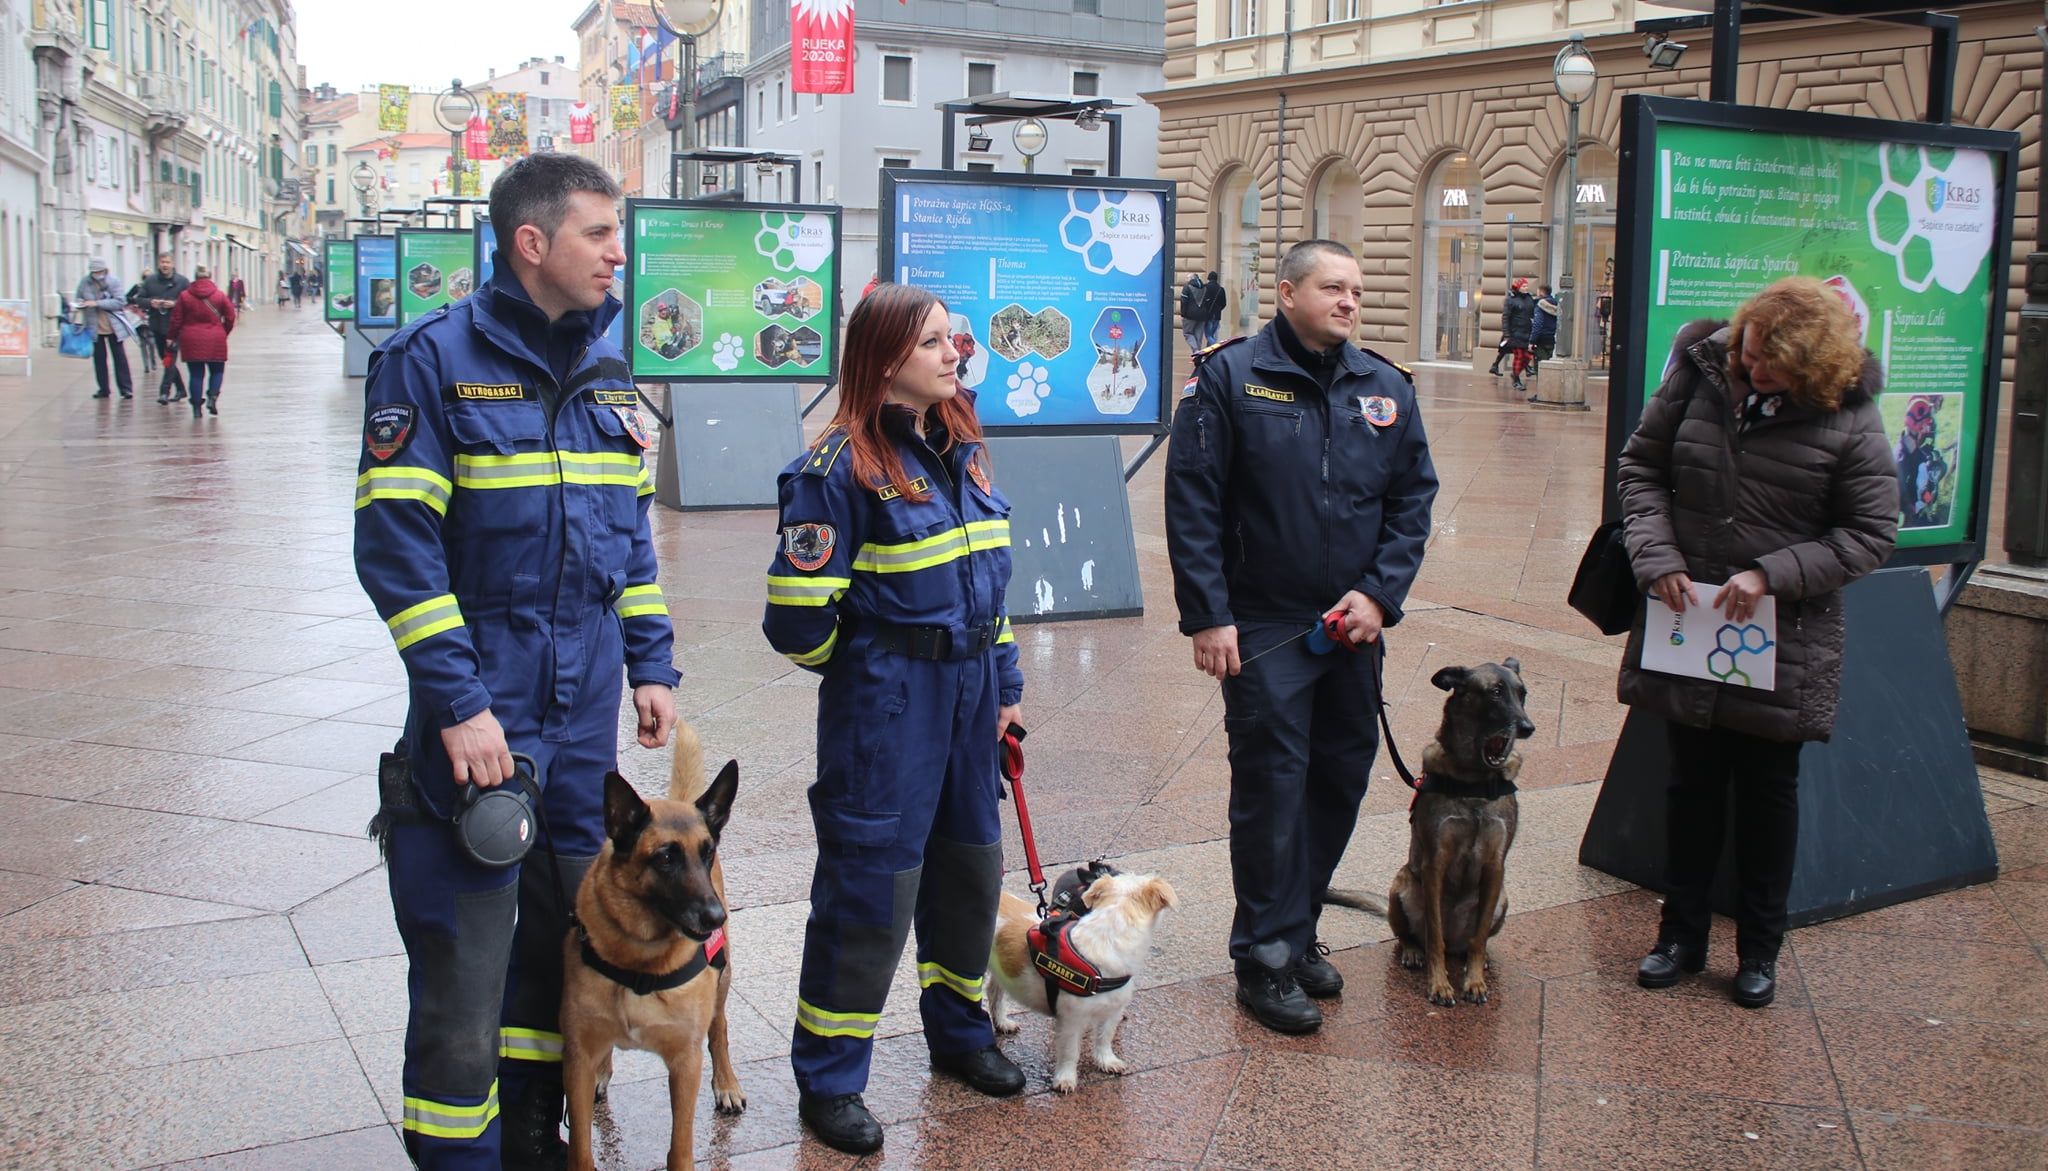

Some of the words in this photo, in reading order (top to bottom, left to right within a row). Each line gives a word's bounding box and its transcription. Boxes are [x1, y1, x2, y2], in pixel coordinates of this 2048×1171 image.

[801, 38, 846, 50] RIJEKA
[801, 50, 847, 62] 2020.eu
[1674, 152, 1691, 166] Pas
[1695, 156, 1706, 167] ne
[1708, 158, 1732, 170] mora
[1735, 153, 1751, 171] biti
[1443, 188, 1468, 206] ZARA
[1576, 184, 1606, 203] ZARA
[1674, 176, 1687, 193] da
[1689, 177, 1699, 194] bi
[1702, 178, 1717, 195] bio
[1714, 184, 1756, 202] potražni
[1754, 188, 1775, 205] pas.
[1798, 190, 1810, 209] je
[913, 197, 950, 209] Potražne
[951, 198, 977, 214] šapice
[979, 198, 1014, 213] HGSS-a,
[912, 212, 943, 224] Stanice
[945, 211, 972, 228] Rijeka
[1674, 204, 1712, 224] instinkt,
[1715, 207, 1742, 224] obuka
[1744, 211, 1749, 224] i
[1750, 208, 1797, 227] konstantan
[1800, 212, 1817, 228] rad
[1945, 223, 1954, 231] na
[911, 266, 945, 278] Dharma
[997, 257, 1026, 269] Thomas
[1672, 250, 1720, 269] Potražna
[1723, 252, 1760, 278] šapica
[1761, 253, 1799, 279] Sparky
[1893, 306, 1925, 333] Šapica
[463, 386, 517, 397] VATROGASAC
[784, 525, 834, 554] K9
[1047, 960, 1075, 980] SPARKY
